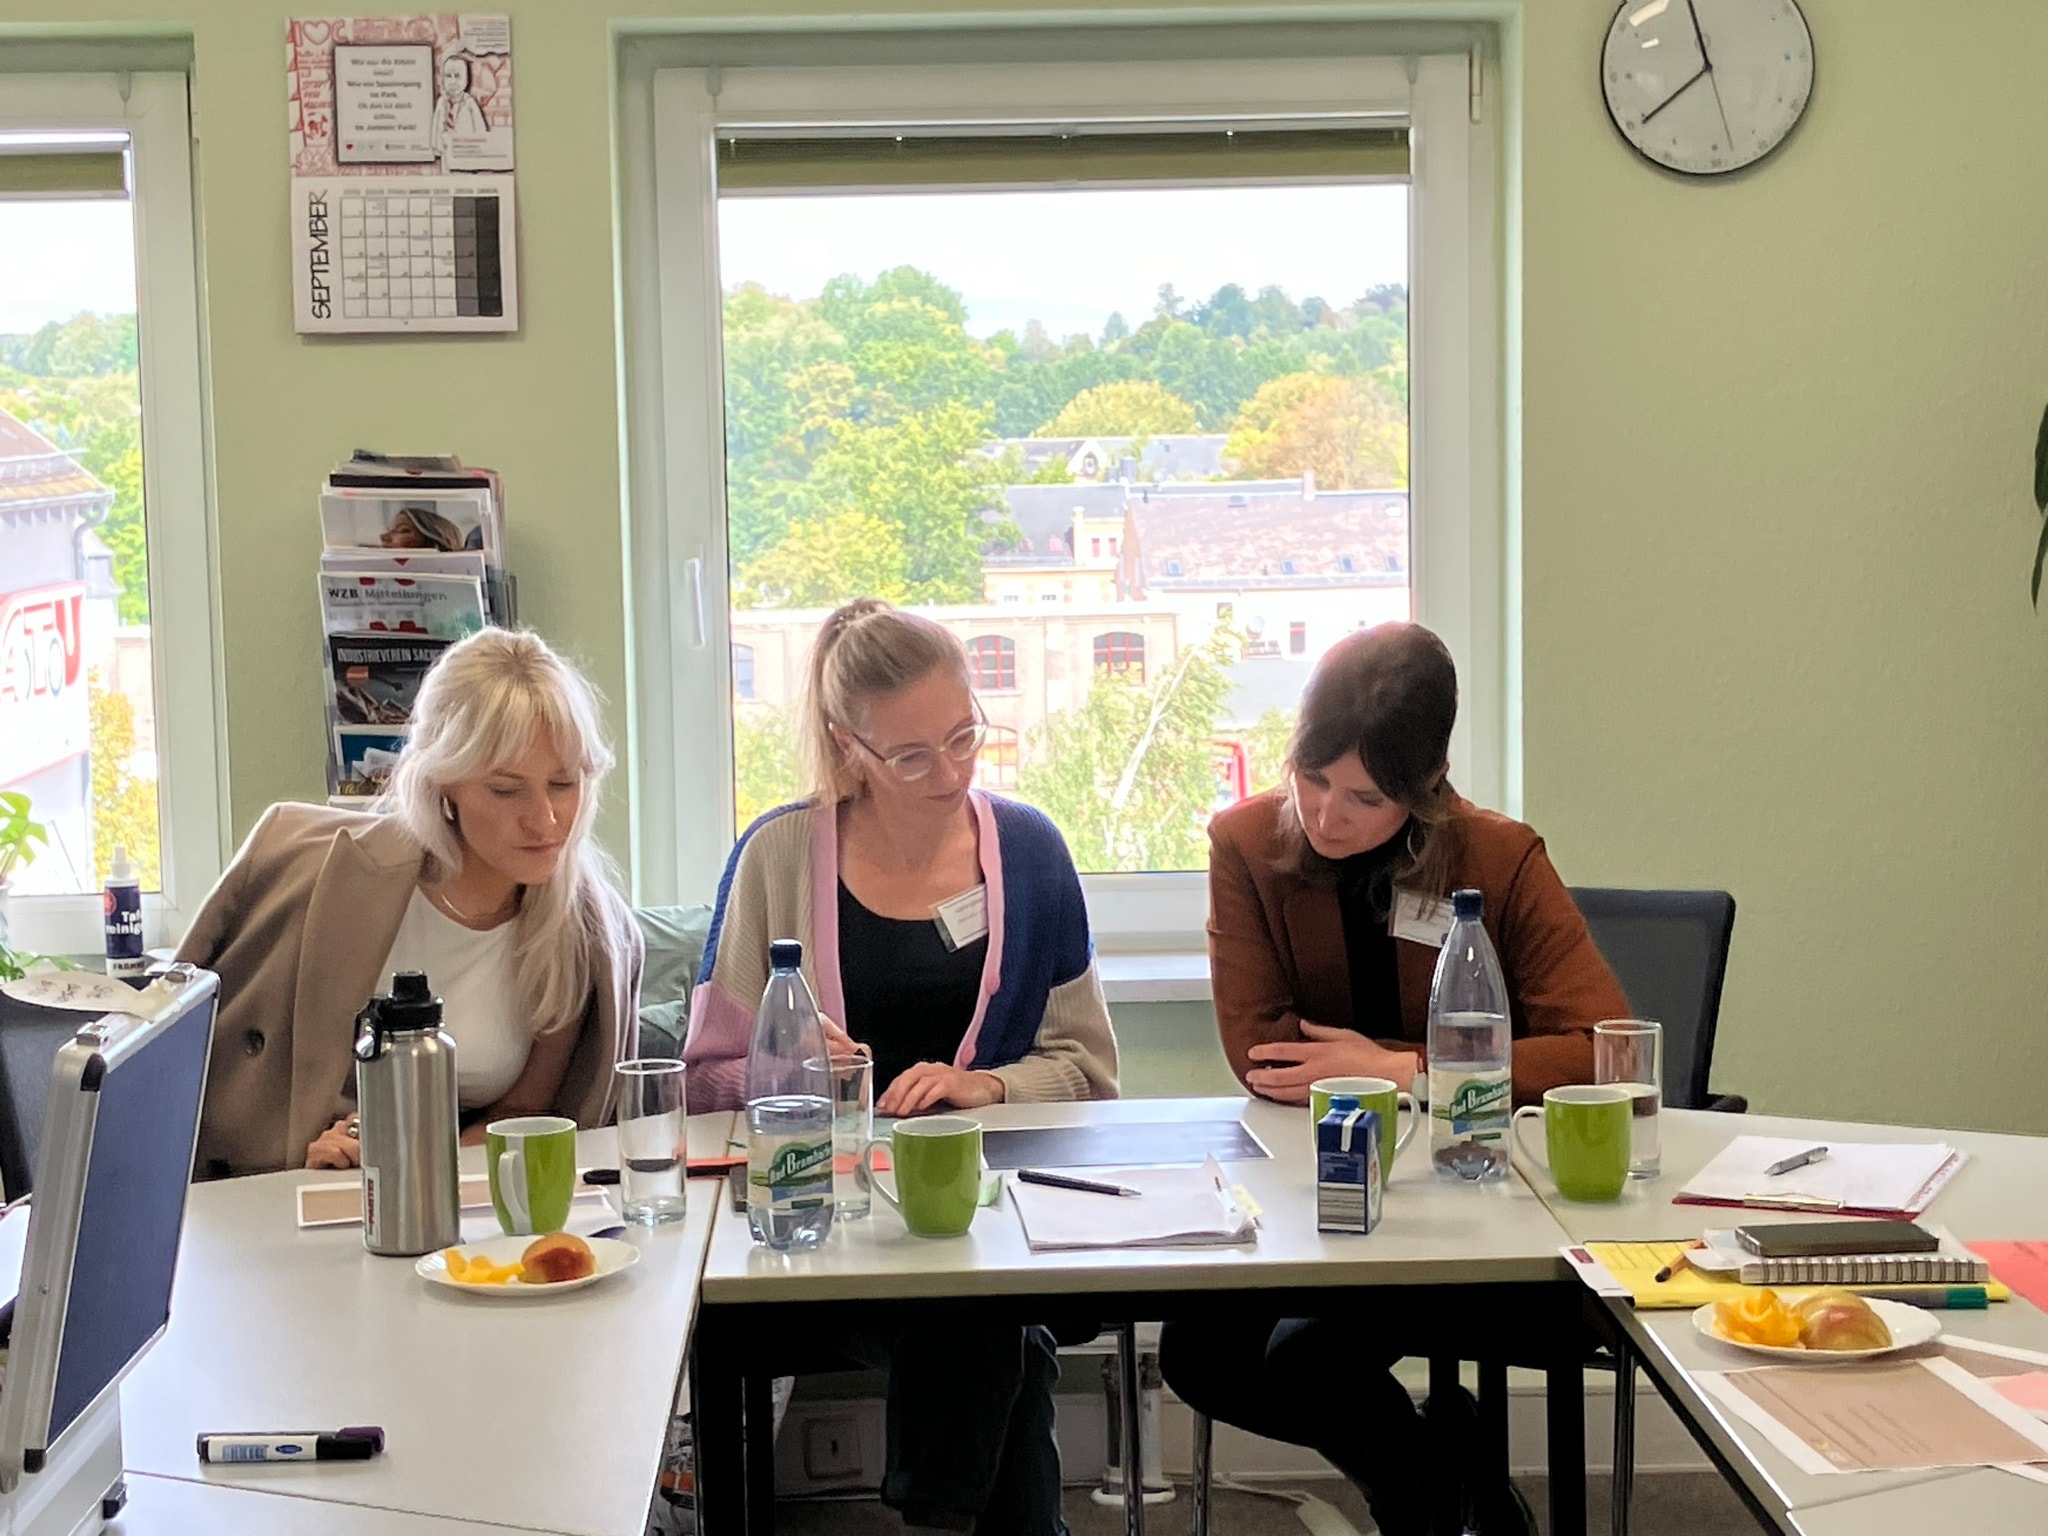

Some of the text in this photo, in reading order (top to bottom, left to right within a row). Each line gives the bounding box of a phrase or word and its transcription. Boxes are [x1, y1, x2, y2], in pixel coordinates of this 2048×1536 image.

[308, 188, 331, 319] SEPTEMBER
[327, 588, 447, 602] WZB Mitteilungen
